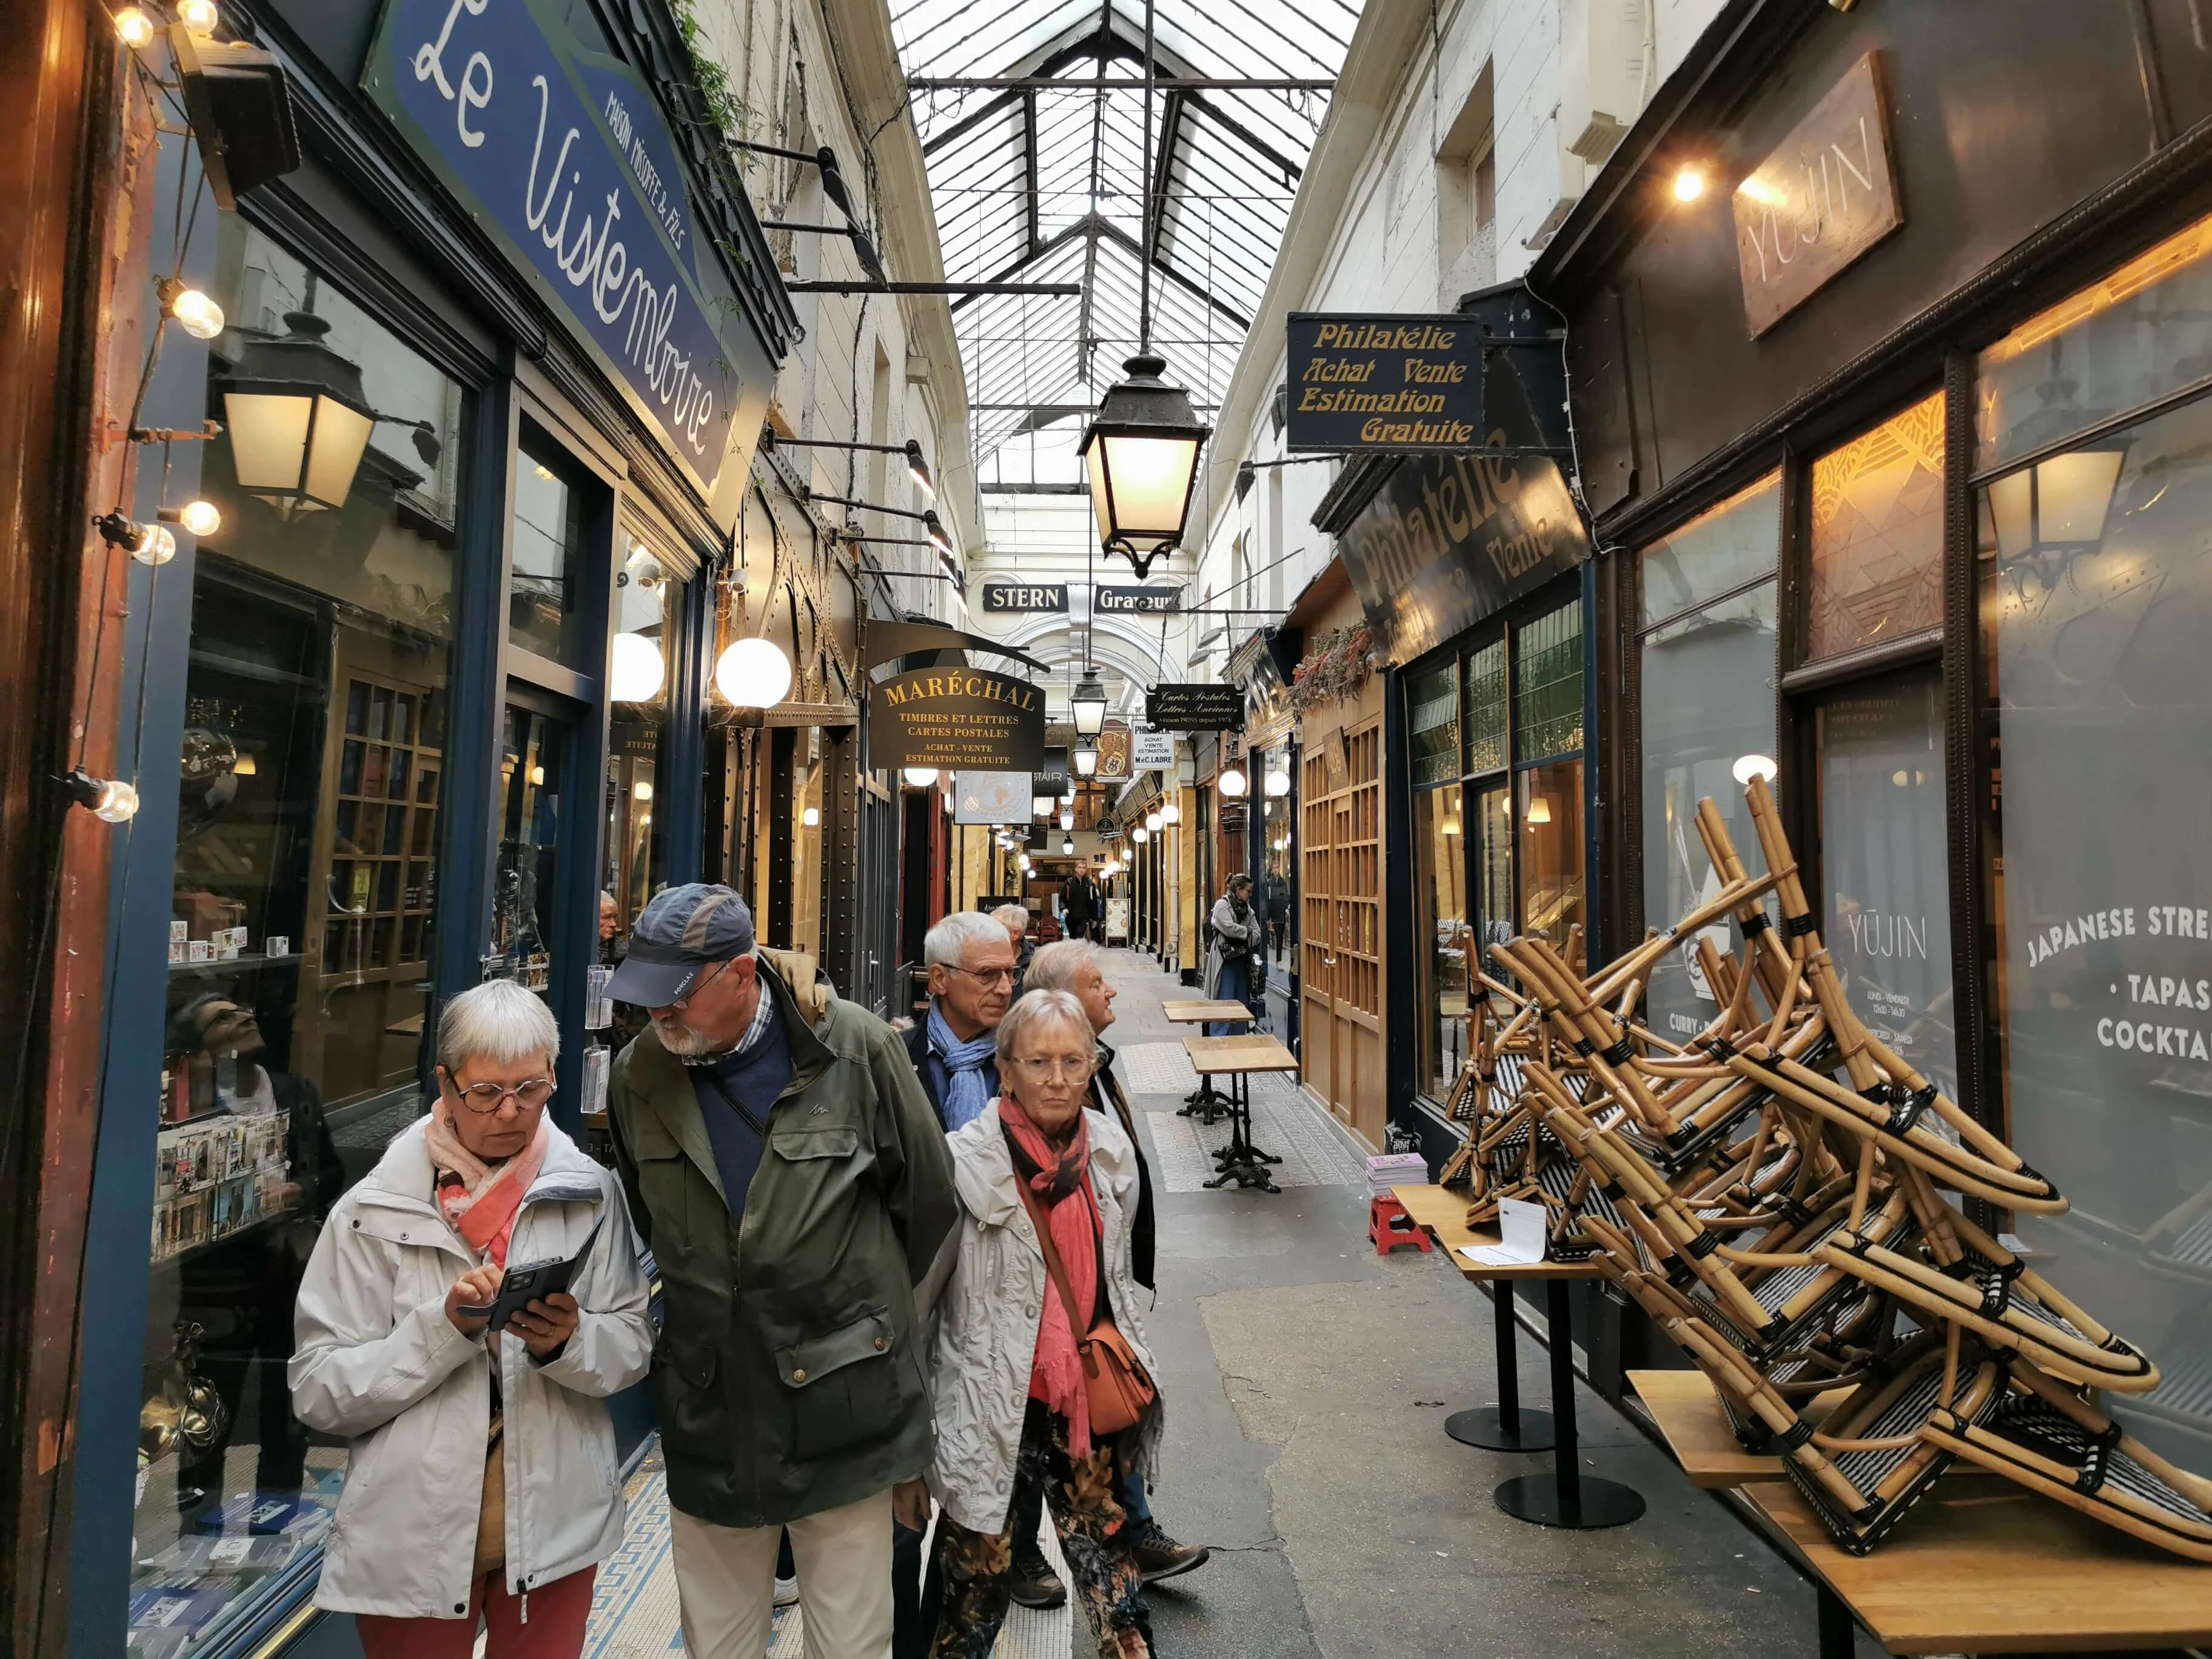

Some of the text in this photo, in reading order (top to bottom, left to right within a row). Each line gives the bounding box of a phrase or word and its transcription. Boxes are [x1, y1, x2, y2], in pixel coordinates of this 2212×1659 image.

[413, 0, 493, 147] Le
[657, 190, 666, 220] &
[526, 75, 713, 455] Vistemboire
[1313, 324, 1456, 350] Philatélie
[1302, 358, 1468, 383] Achat Vente
[1297, 387, 1446, 412] Estimation
[1361, 418, 1474, 443] Gratuite
[1360, 427, 1520, 607] Philatélie
[1485, 517, 1555, 585] Vente
[992, 588, 1173, 609] STERN Graeur
[883, 671, 1036, 712] MARÉCHAL
[1161, 690, 1230, 702] Cartes Postales
[899, 713, 1019, 725] TIMBRES ET LETTRES
[1155, 702, 1187, 714] Lettres
[908, 726, 1009, 738] CARTES POSTALES
[906, 754, 1011, 765] ESTIMATION GRATUITE
[924, 743, 955, 751] ACHAT
[962, 744, 993, 752] VENTE
[2027, 906, 2212, 968] JAPANESE STRE
[674, 971, 694, 995] FORCLAZ
[2128, 974, 2211, 1010] TAPAS
[1669, 1013, 1698, 1035] CURRY
[2097, 1017, 2212, 1062] COCKTA
